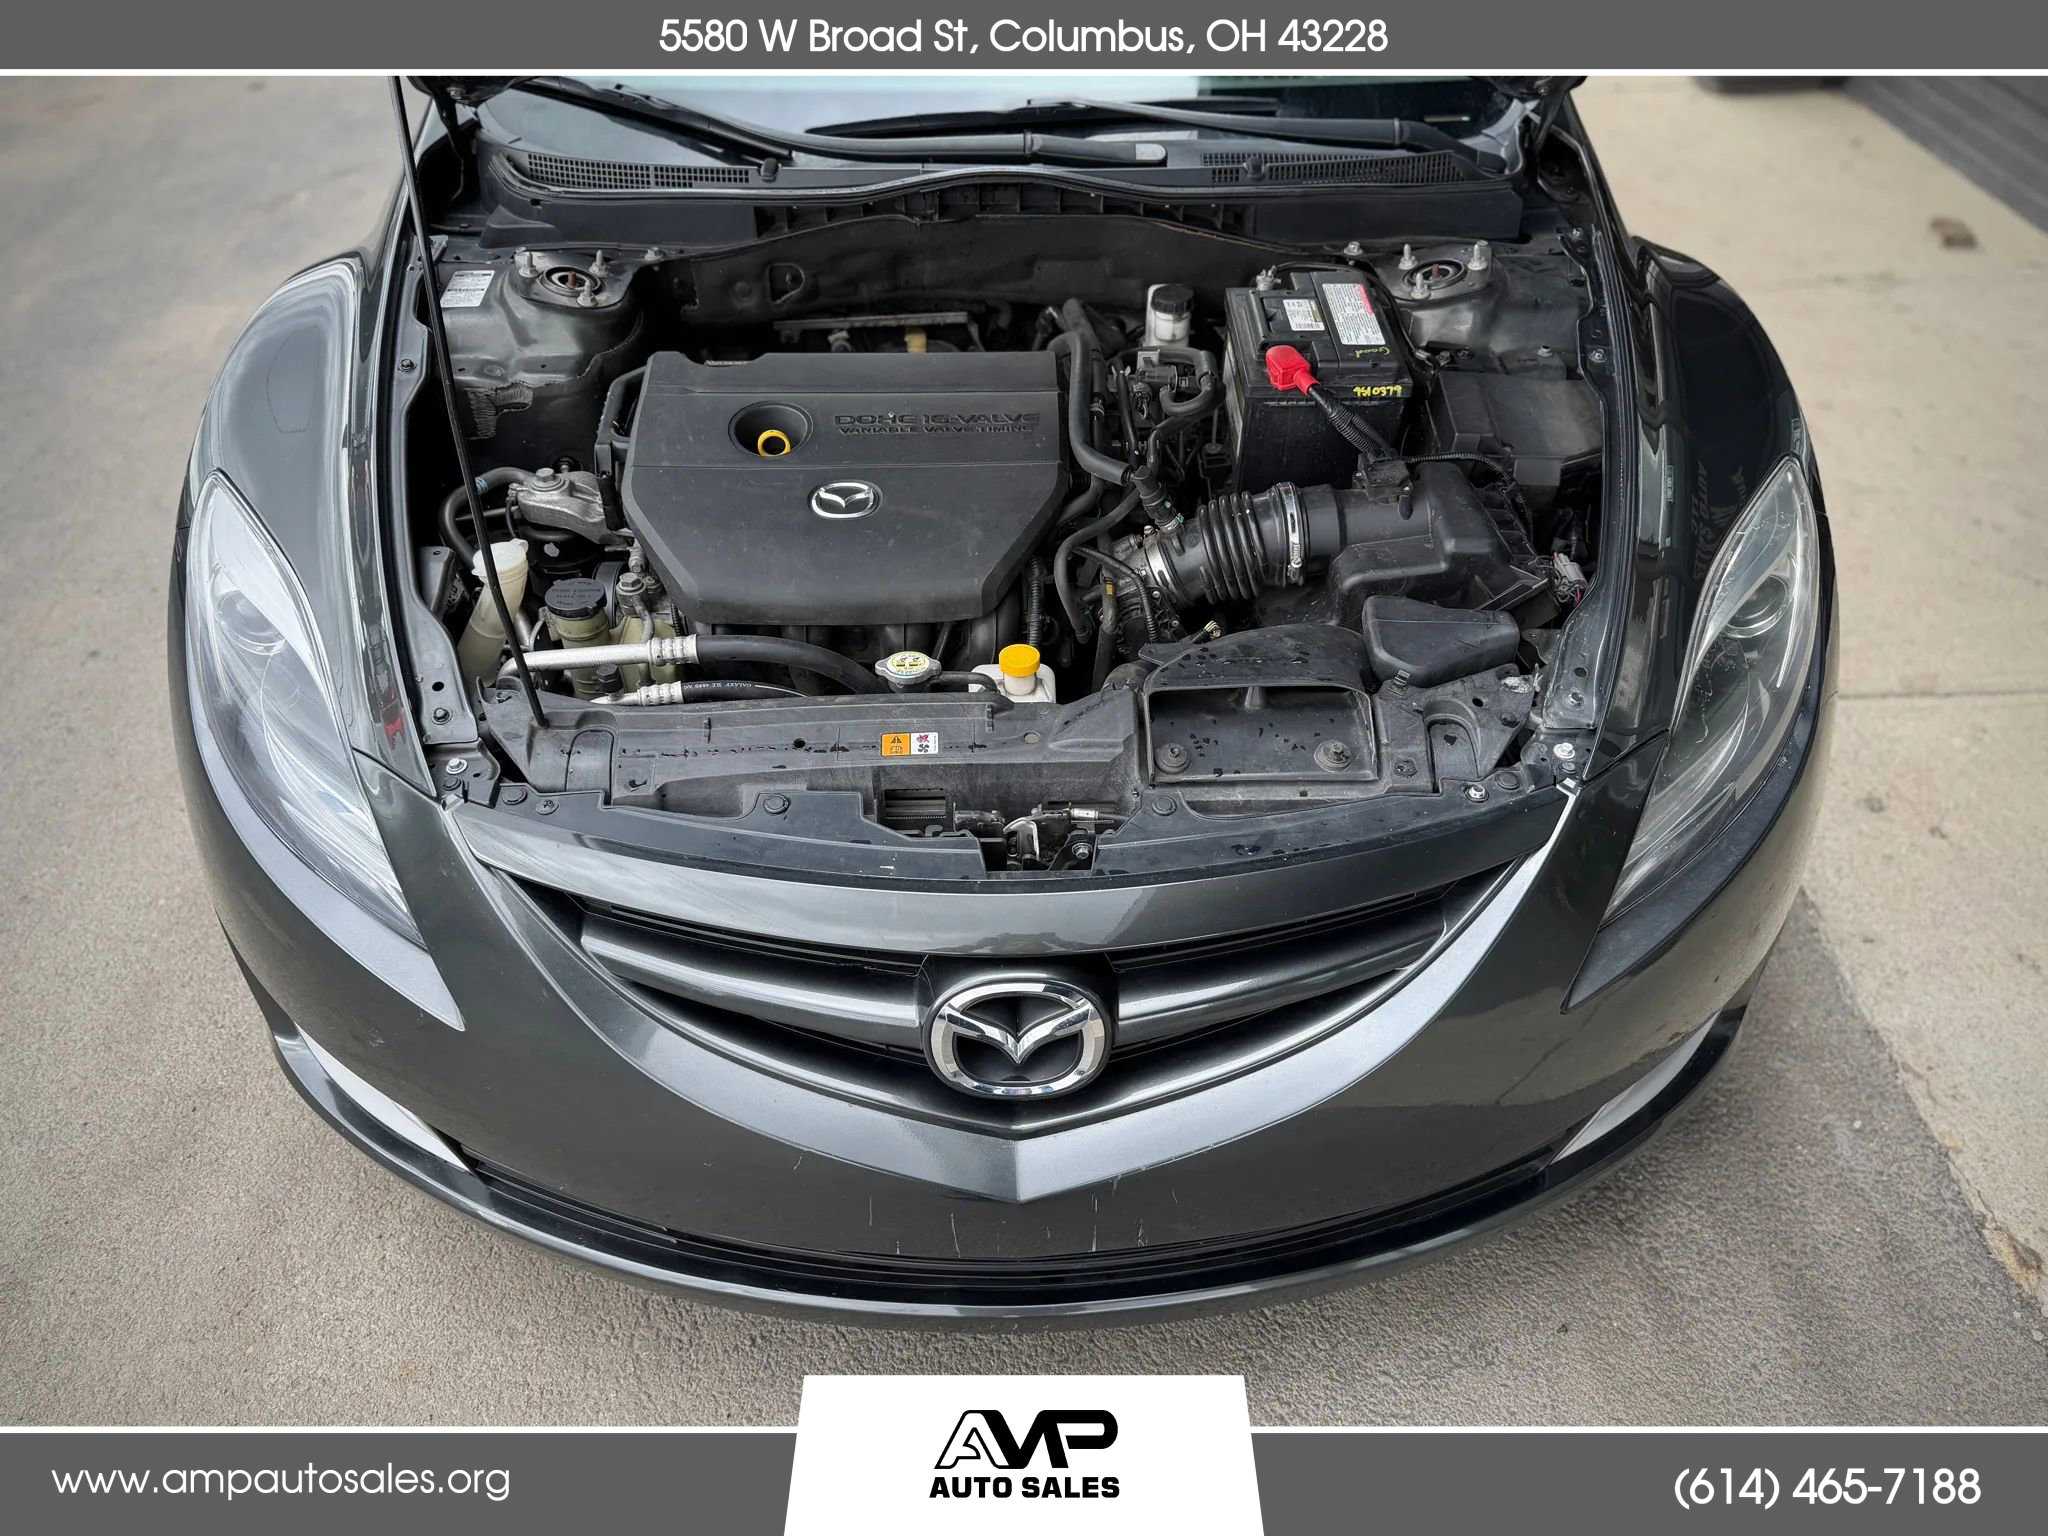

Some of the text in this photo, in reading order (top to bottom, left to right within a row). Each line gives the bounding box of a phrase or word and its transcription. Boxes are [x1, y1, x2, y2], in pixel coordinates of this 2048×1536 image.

[834, 413, 1041, 425] DOHC 16-VALVE
[839, 425, 1034, 434] VARIABLE VALVE TIMING
